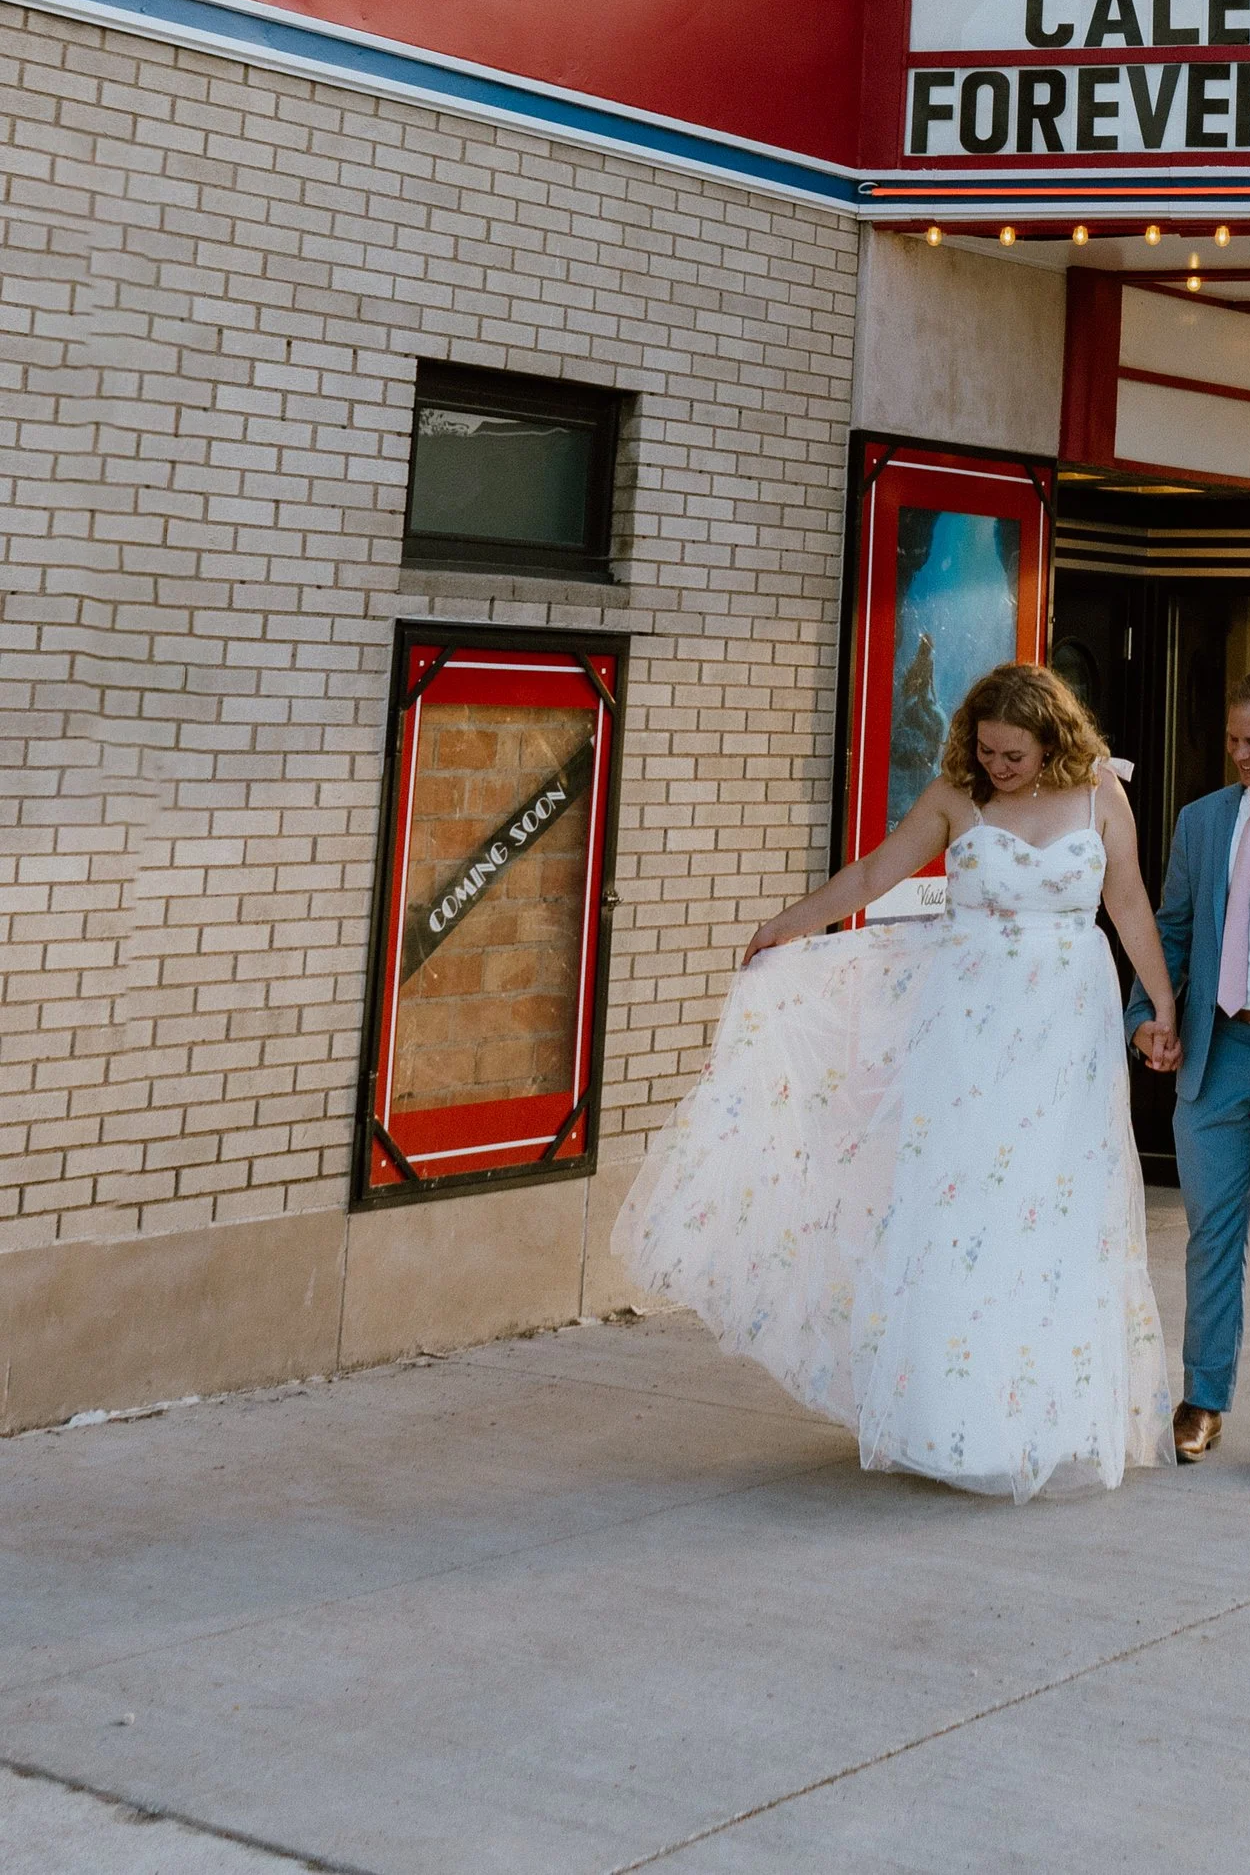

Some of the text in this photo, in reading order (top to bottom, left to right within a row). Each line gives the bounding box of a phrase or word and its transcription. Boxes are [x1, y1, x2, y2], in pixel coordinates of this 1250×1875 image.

[429, 781, 567, 933] COMING SOON
[917, 884, 945, 906] Visit
